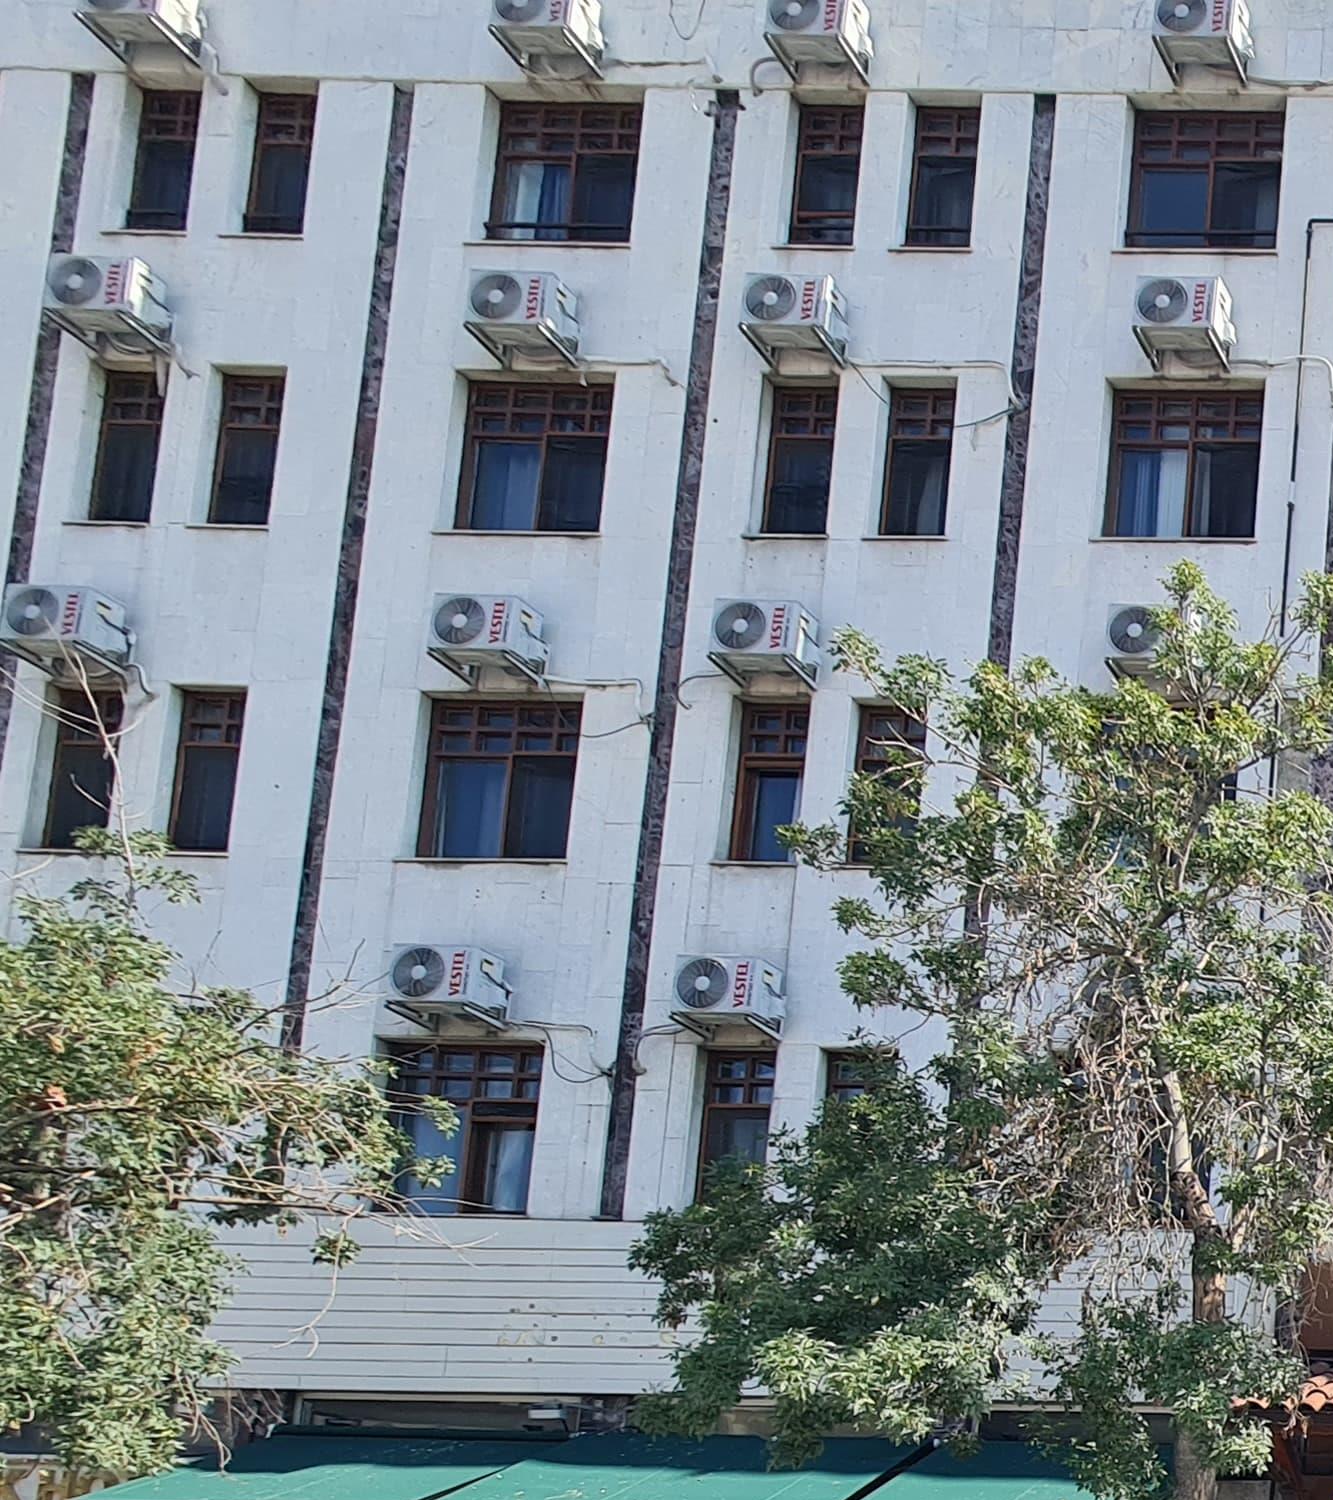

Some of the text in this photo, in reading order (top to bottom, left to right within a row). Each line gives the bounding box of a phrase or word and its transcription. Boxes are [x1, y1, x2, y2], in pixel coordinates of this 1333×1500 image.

[525, 276, 541, 320] VESTEL
[800, 279, 817, 321] VESTEL
[1192, 282, 1207, 323] VESTEL
[487, 599, 507, 644] VESTEL
[769, 603, 787, 649] VESTEL
[448, 950, 467, 997] VESTEL
[731, 960, 750, 1008] VESTEL
